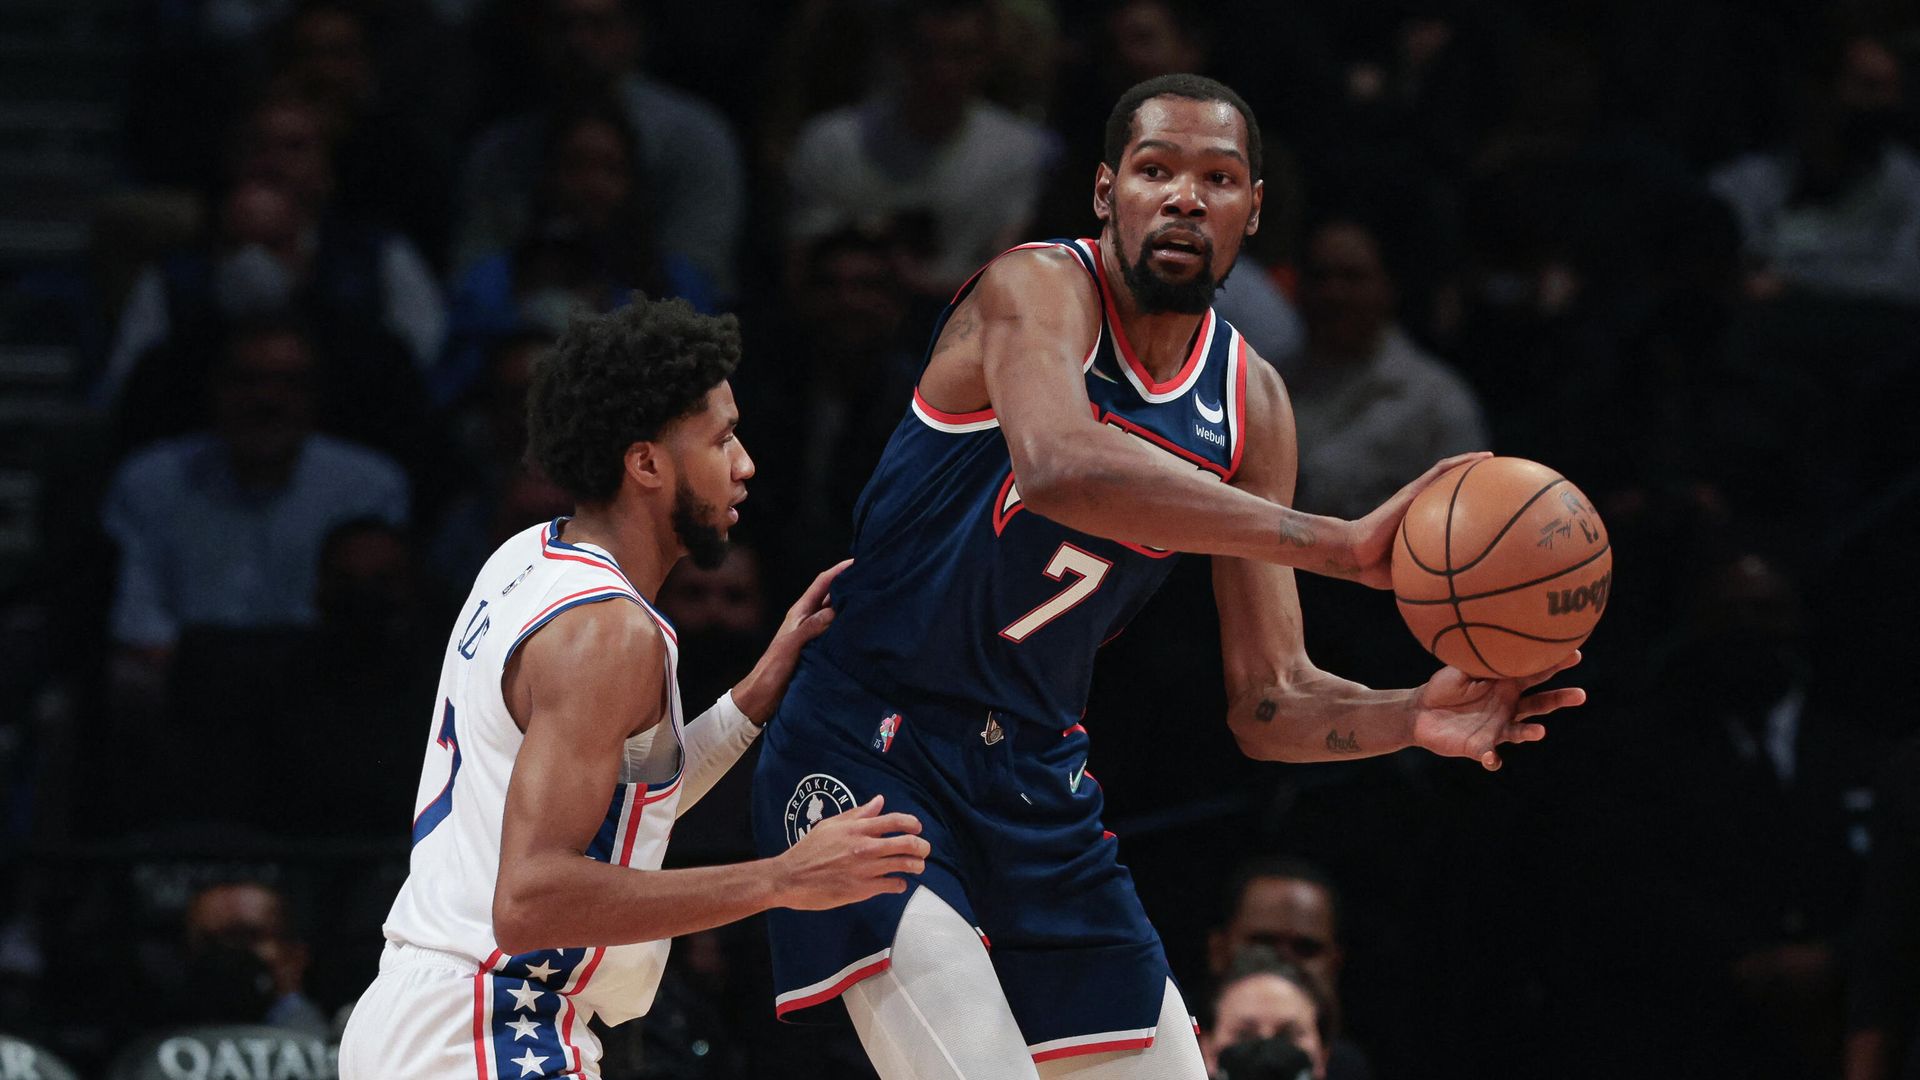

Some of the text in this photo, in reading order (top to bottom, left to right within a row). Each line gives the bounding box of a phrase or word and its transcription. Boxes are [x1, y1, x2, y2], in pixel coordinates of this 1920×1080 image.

[1195, 424, 1225, 447] Webull
[1000, 541, 1112, 644] 7
[1546, 570, 1610, 615] lson
[788, 779, 849, 821] BROOKLYN
